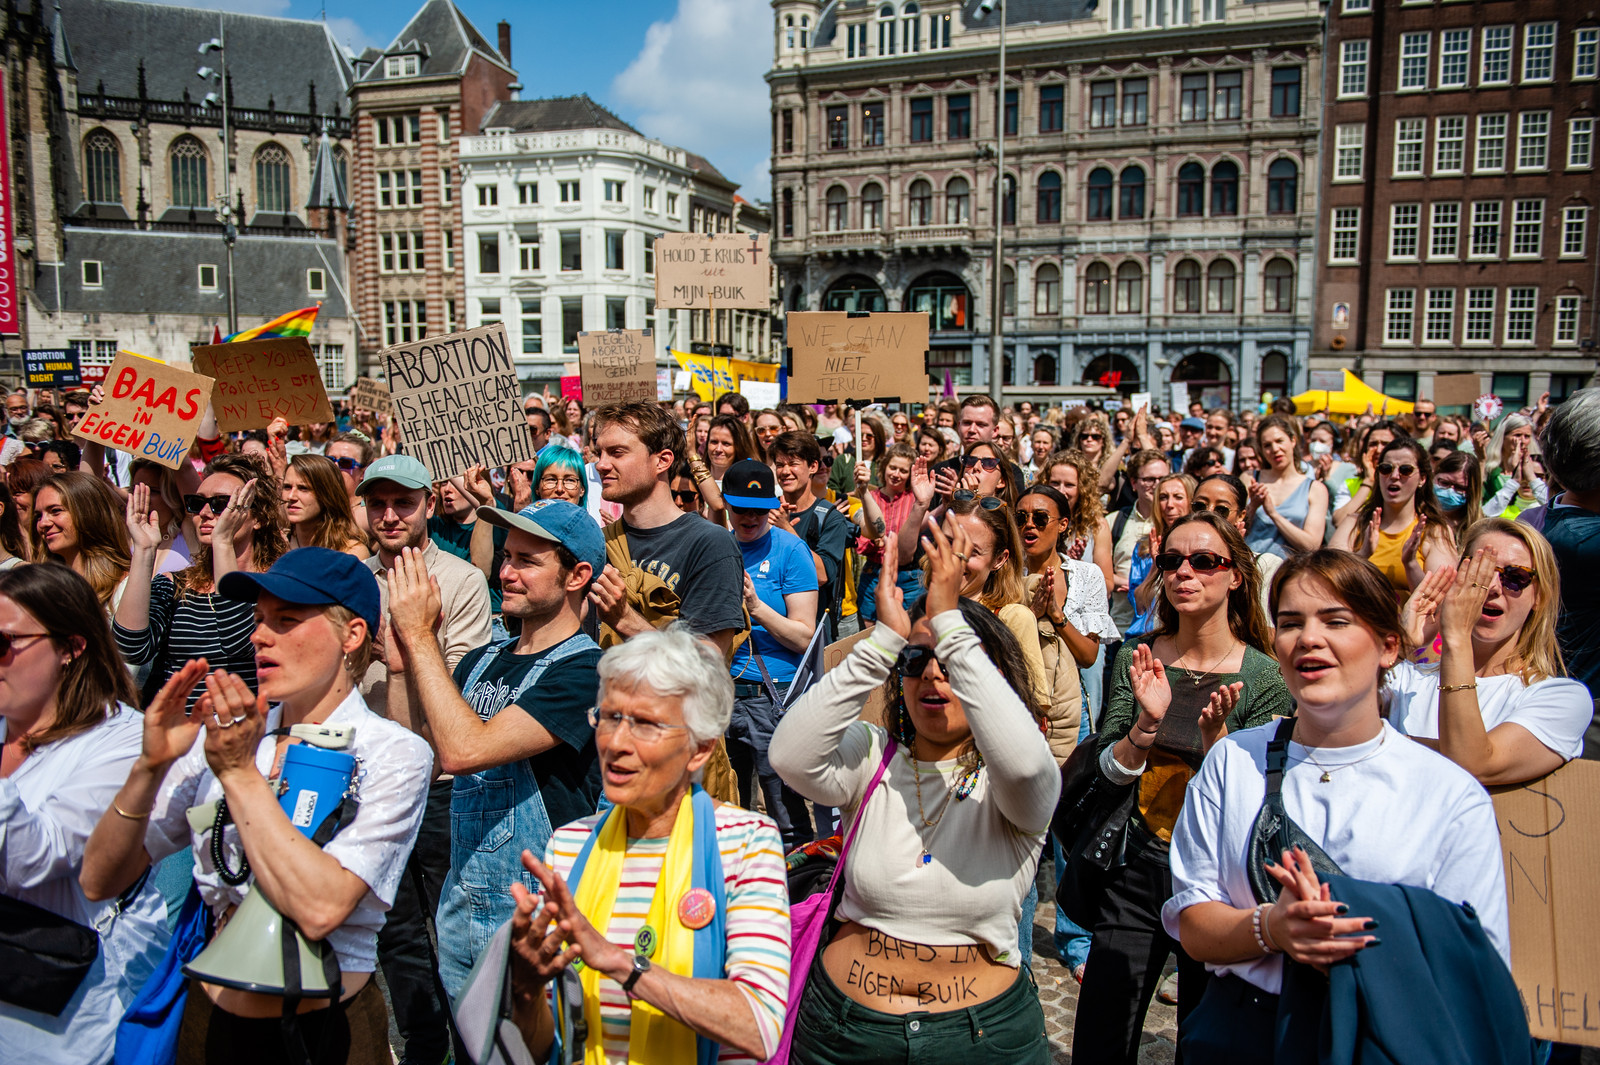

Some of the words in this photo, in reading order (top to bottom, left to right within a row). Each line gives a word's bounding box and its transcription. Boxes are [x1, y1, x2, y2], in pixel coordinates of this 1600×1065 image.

[663, 248, 695, 263] HOUD
[700, 248, 712, 264] JE
[715, 248, 745, 263] KRUIS
[673, 285, 704, 306] MIJN
[713, 285, 745, 300] BUIK
[594, 334, 634, 345] TEGEN
[801, 324, 836, 347] WE
[846, 324, 906, 349] GAAN
[26, 352, 65, 360] ABORTION
[592, 343, 642, 357] ABORTUS?
[28, 363, 37, 371] IS
[38, 363, 44, 371] A
[45, 362, 73, 371] HUMAN
[208, 351, 255, 377] KEEP
[262, 349, 309, 368] YOUR
[386, 331, 511, 393] ABORTION
[593, 356, 628, 369] NEEM
[629, 356, 644, 366] ER
[605, 366, 637, 379] GEEN!
[825, 356, 866, 372] NIET
[29, 373, 54, 382] RIGHT
[816, 374, 880, 394] TERUG!!
[112, 366, 201, 421] BAAS
[396, 396, 417, 422] IS
[418, 373, 521, 417] HEALTHCARE
[592, 390, 617, 401] ONZE
[222, 401, 248, 419] MY
[257, 392, 319, 419] BODY
[401, 404, 495, 443] HEALTHCARE
[494, 400, 509, 423] IS
[511, 399, 526, 422] A
[477, 422, 533, 469] RIGHT
[303, 794, 317, 826] VONYX
[865, 927, 937, 962] BAAS
[950, 944, 979, 963] IN
[847, 959, 904, 1004] EIGEN
